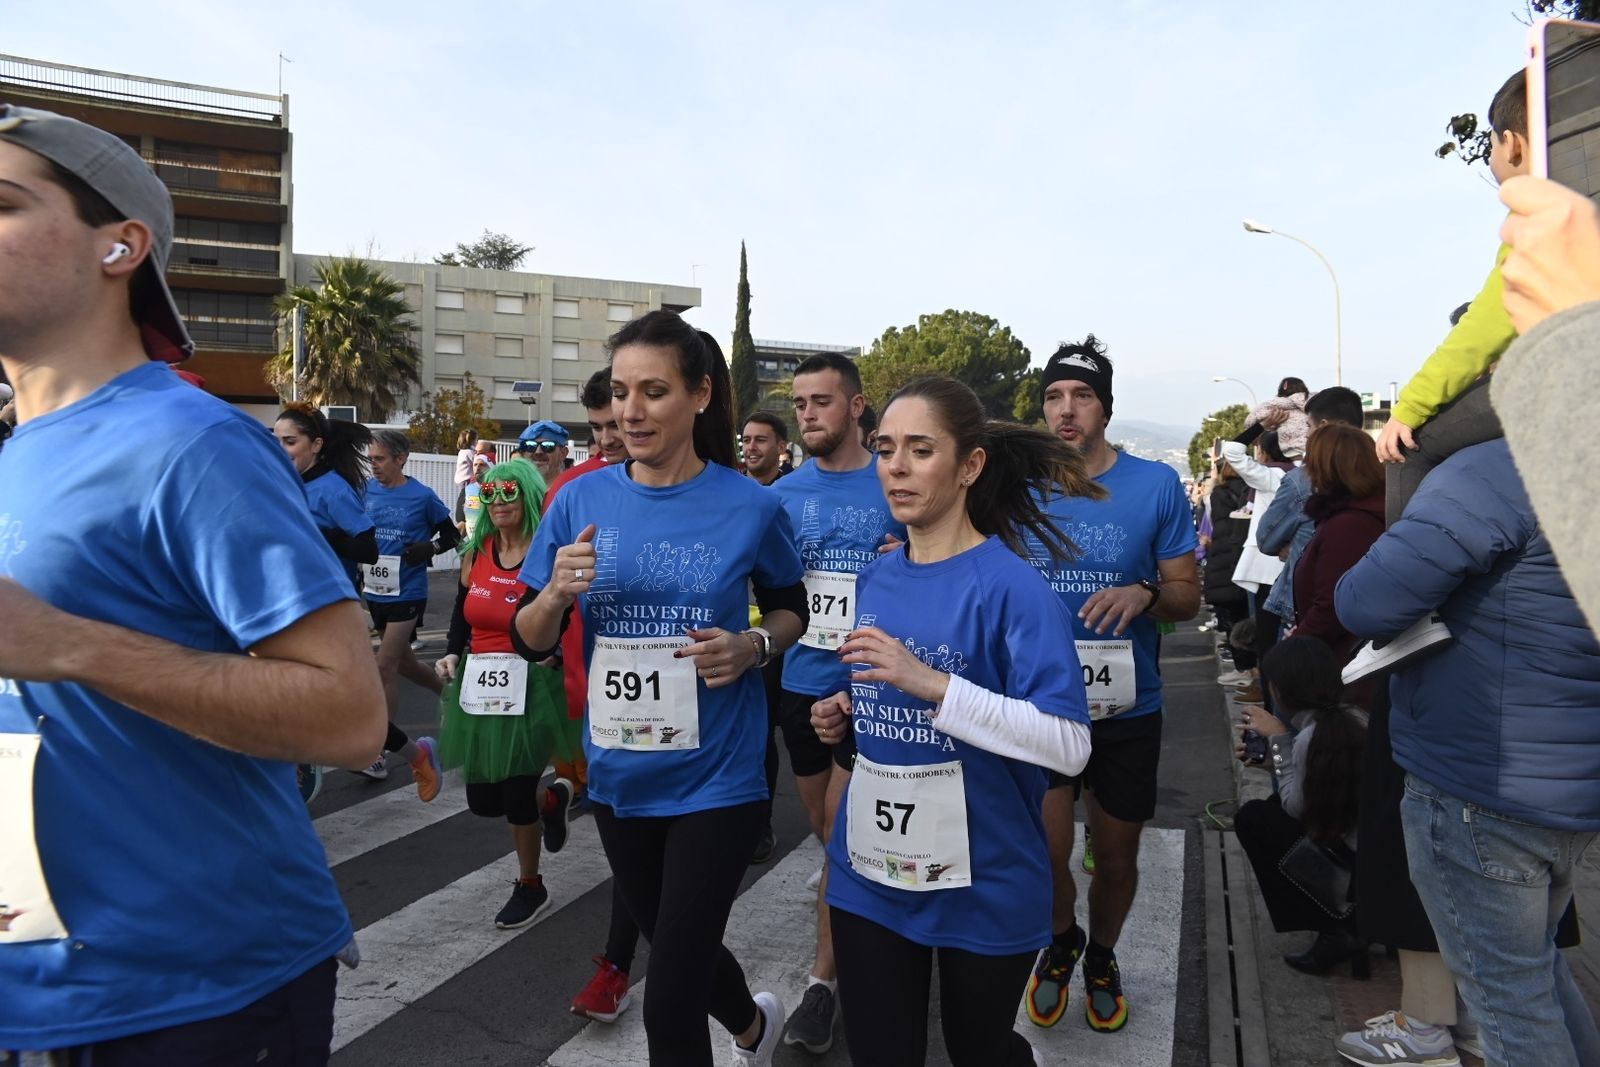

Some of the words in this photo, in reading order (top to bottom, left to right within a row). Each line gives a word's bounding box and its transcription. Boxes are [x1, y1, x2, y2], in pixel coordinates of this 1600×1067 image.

[370, 566, 389, 578] 466
[806, 561, 867, 572] CORDOBES
[1053, 570, 1123, 582] SILVESTRE
[1051, 582, 1113, 593] RDOBES
[622, 604, 714, 622] SILVESTRE
[604, 643, 640, 651] SILVESTRE
[642, 642, 689, 650] CORDOBESA
[477, 670, 510, 687] 453
[605, 670, 661, 701] 591
[851, 699, 875, 718] AN
[878, 704, 934, 727] SILVES
[854, 718, 957, 752] CORDOBEA
[902, 768, 956, 779] CORDOBESA
[875, 799, 916, 836] 57
[1382, 1042, 1408, 1060] N
